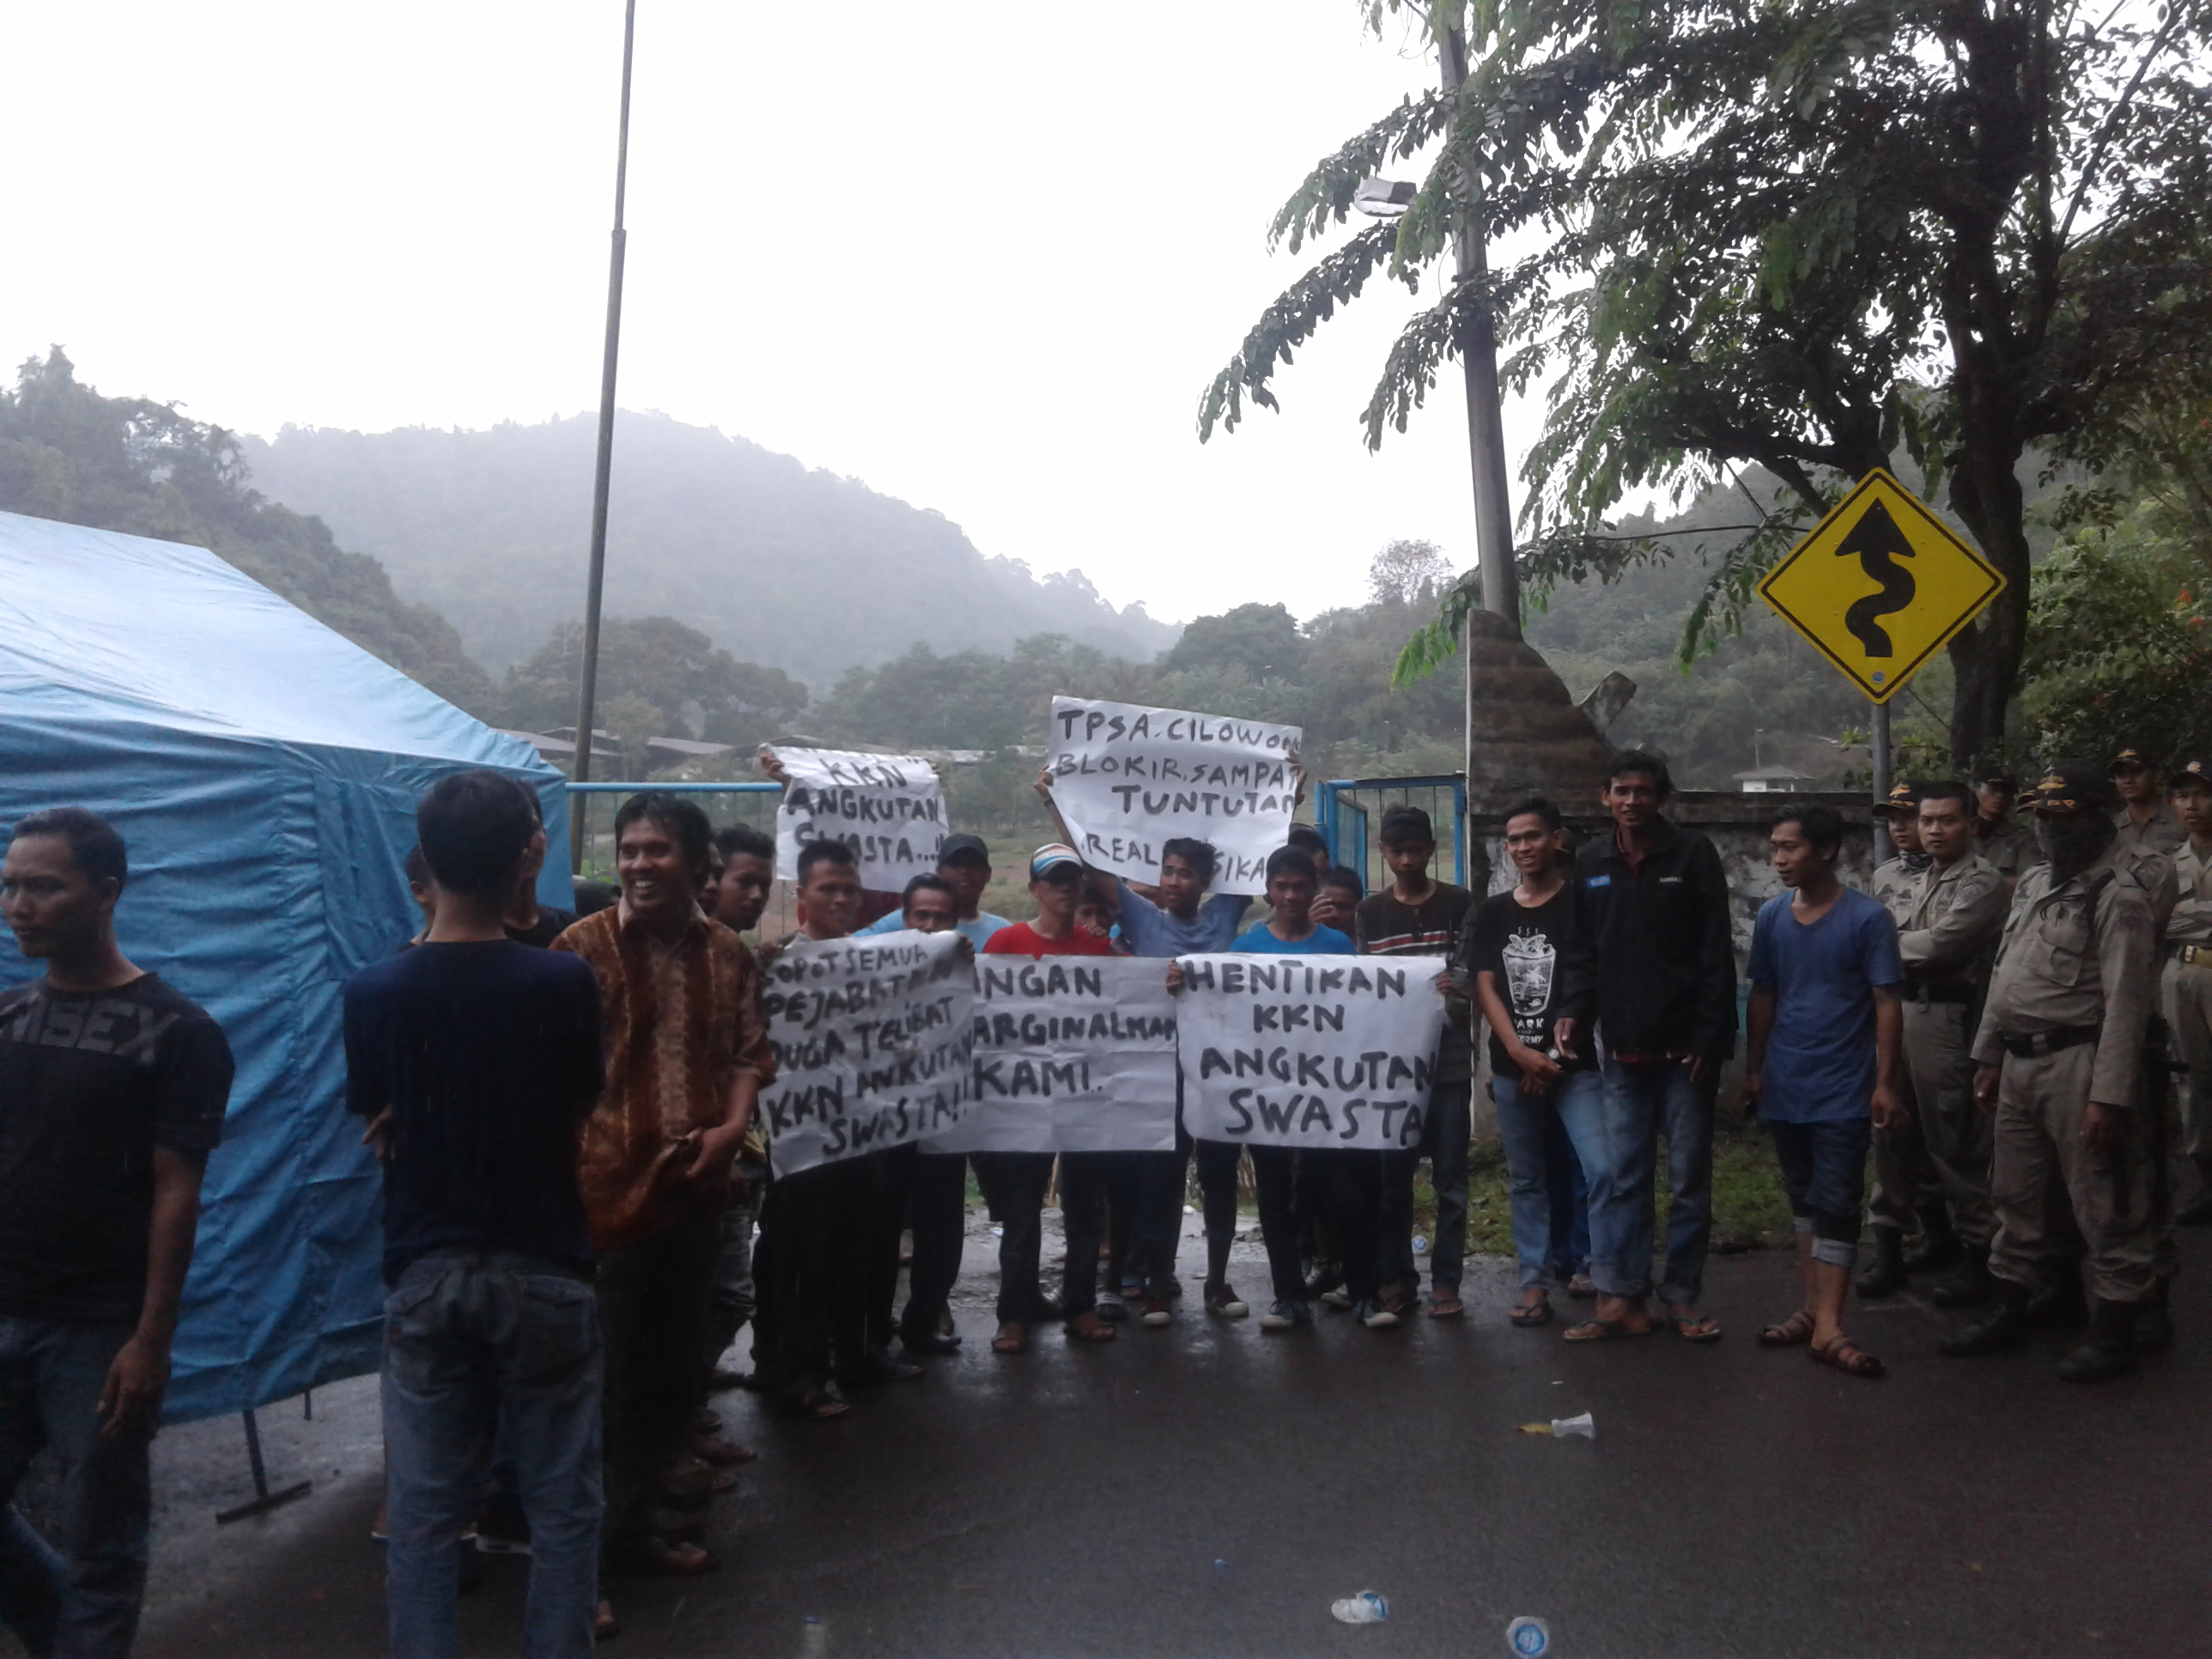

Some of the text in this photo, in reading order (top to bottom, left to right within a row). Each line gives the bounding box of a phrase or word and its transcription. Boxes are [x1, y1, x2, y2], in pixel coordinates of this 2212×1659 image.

[818, 757, 908, 788] KKN
[787, 787, 939, 823] ANGKUTAN
[765, 950, 839, 987] OPOT
[845, 944, 929, 981] SEMUA
[1184, 959, 1407, 1000] HENTIKAN
[1253, 1004, 1346, 1033] KKN
[1200, 1046, 1436, 1092] ANGKUTAN
[767, 1075, 843, 1139] KKN
[1224, 1088, 1423, 1147] SWASTA
